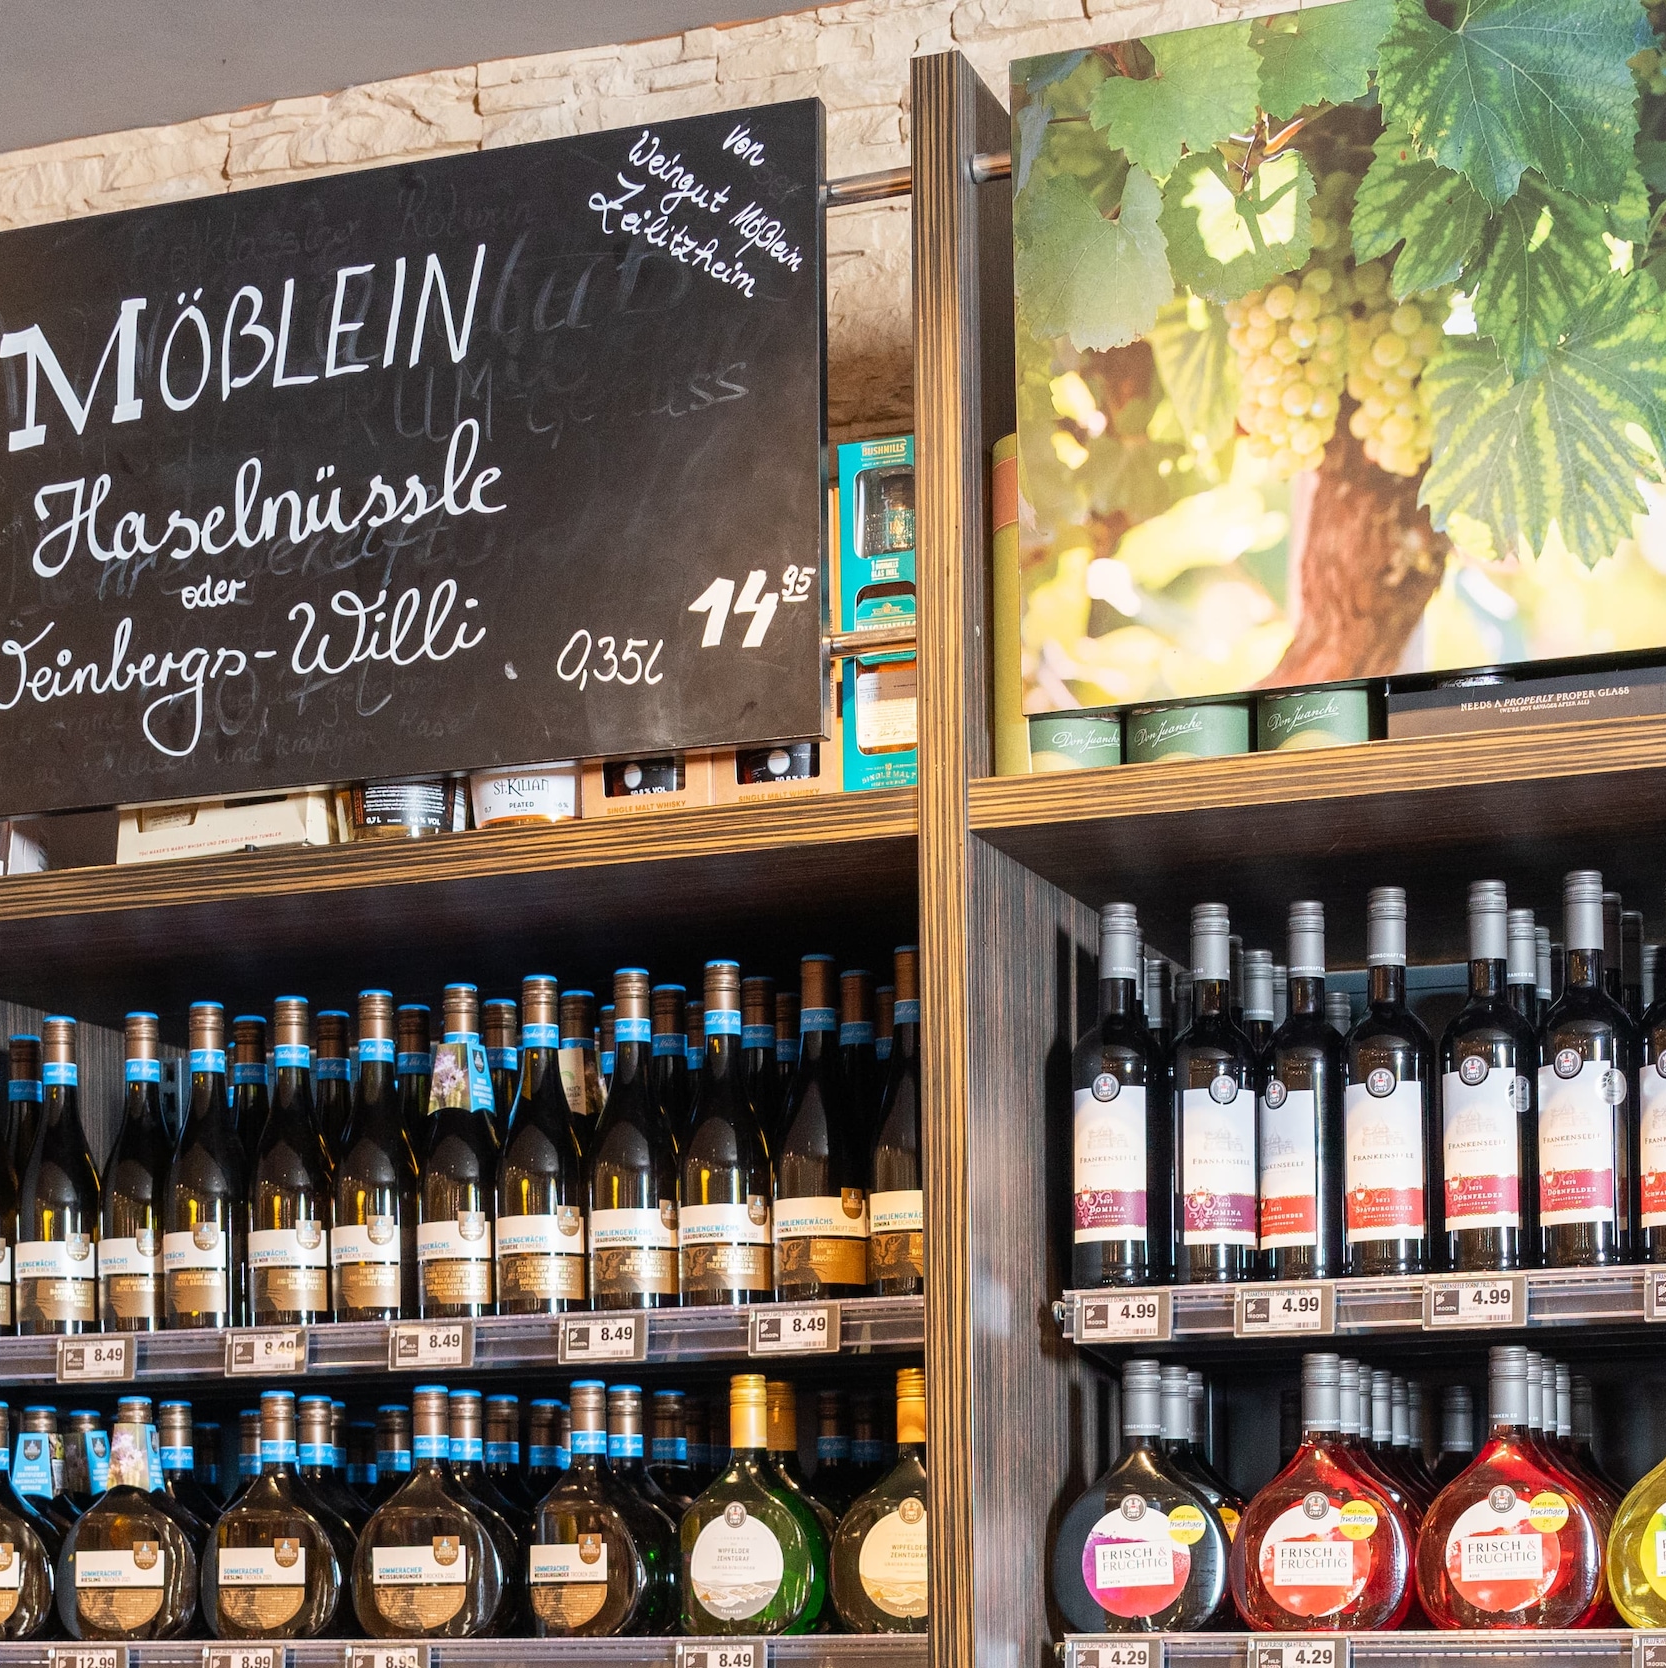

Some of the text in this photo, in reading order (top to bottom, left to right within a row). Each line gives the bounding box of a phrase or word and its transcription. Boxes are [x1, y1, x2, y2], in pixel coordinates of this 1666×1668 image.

[628, 130, 730, 213] Weingut
[860, 442, 906, 456] BUSHMILLS
[32, 419, 507, 578] Haselnüssle
[181, 575, 247, 610] oder
[1461, 686, 1630, 712] NEEDS A PROPERLY PROPER GLASS
[607, 800, 686, 815] SINGLE MALT WHISKY
[776, 1217, 834, 1228] FAMILIENGEWÄCHS
[600, 1326, 633, 1341] 8.49
[1101, 1544, 1153, 1559] FRISCH
[223, 1567, 264, 1576] SOMMERACHER
[1101, 1556, 1170, 1573] FRUCHTIG
[718, 1652, 752, 1668] 8.49
